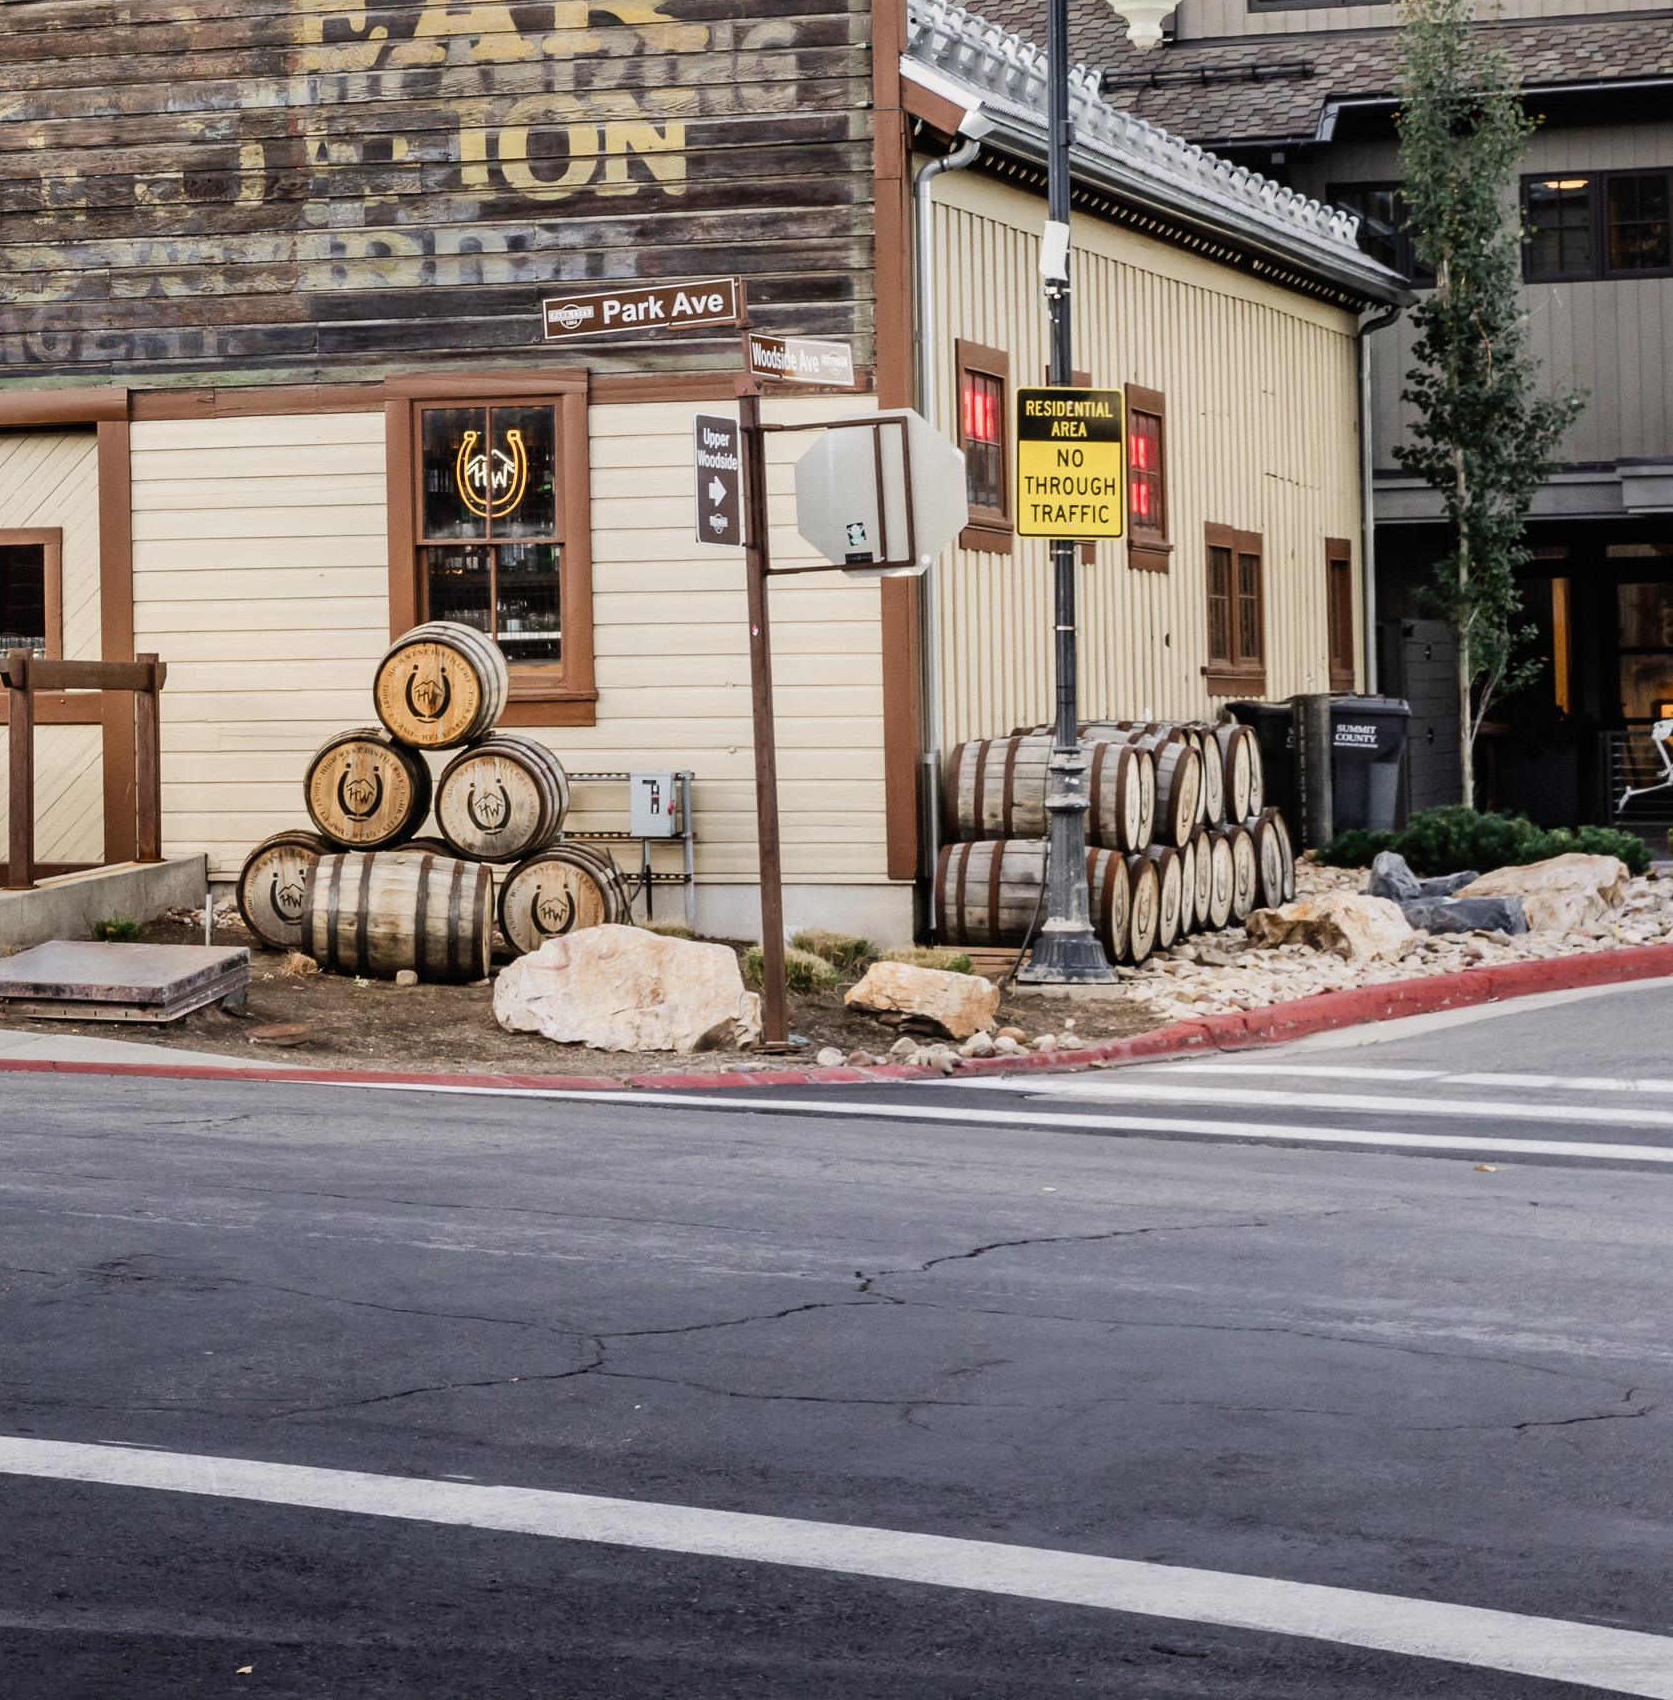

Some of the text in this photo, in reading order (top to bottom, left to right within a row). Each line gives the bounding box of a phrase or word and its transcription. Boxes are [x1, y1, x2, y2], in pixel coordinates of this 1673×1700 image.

[603, 292, 724, 324] Park Ave
[752, 342, 797, 371] Woodside
[799, 350, 820, 373] Ave
[1025, 400, 1113, 418] RESIDENTIAL
[703, 427, 730, 449] Upper
[1051, 421, 1088, 437] AREA
[697, 449, 738, 470] Woodside
[1057, 449, 1084, 467] NO
[1024, 476, 1116, 496] THROUGH
[1030, 504, 1109, 524] TRAFFIC
[1335, 733, 1377, 743] COUNTY
[1336, 724, 1377, 734] SUMMIT
[541, 907, 567, 922] HW
